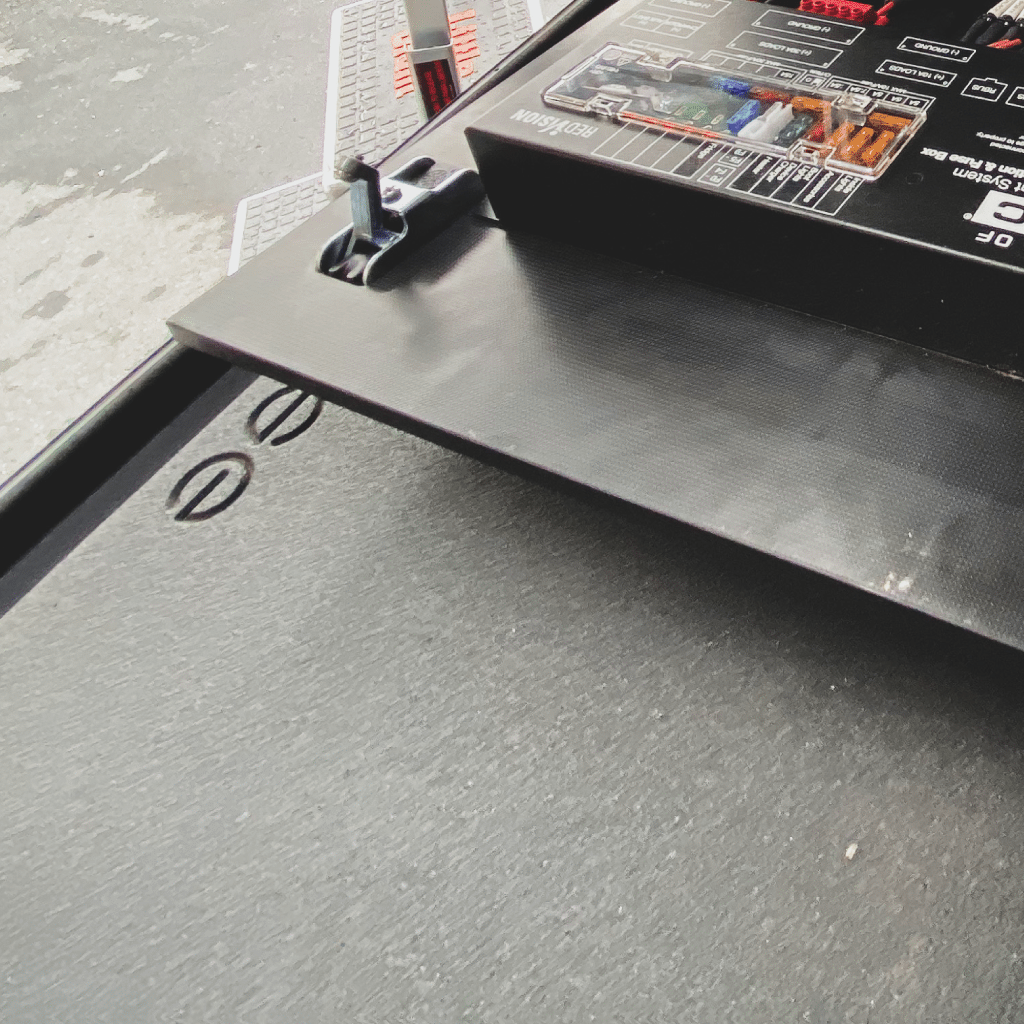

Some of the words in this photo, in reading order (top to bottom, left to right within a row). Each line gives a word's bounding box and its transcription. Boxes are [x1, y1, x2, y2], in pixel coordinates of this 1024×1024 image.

[787, 20, 821, 31] GROUND
[758, 41, 786, 51] LOADS
[914, 42, 950, 54] GROUND
[888, 65, 917, 76] LOADS
[918, 70, 932, 79] 10A
[971, 84, 997, 94] RBUS
[697, 143, 717, 159] Fridge
[920, 147, 948, 162] Box
[948, 153, 984, 169] Fuse
[984, 161, 997, 172] &
[766, 161, 789, 183] Charger
[777, 162, 798, 181] Device
[792, 166, 811, 182] Lights
[803, 167, 819, 181] Boot
[952, 167, 1012, 190] System
[803, 171, 835, 203] Accessories
[834, 175, 853, 192] Lights
[974, 230, 1014, 248] OF
